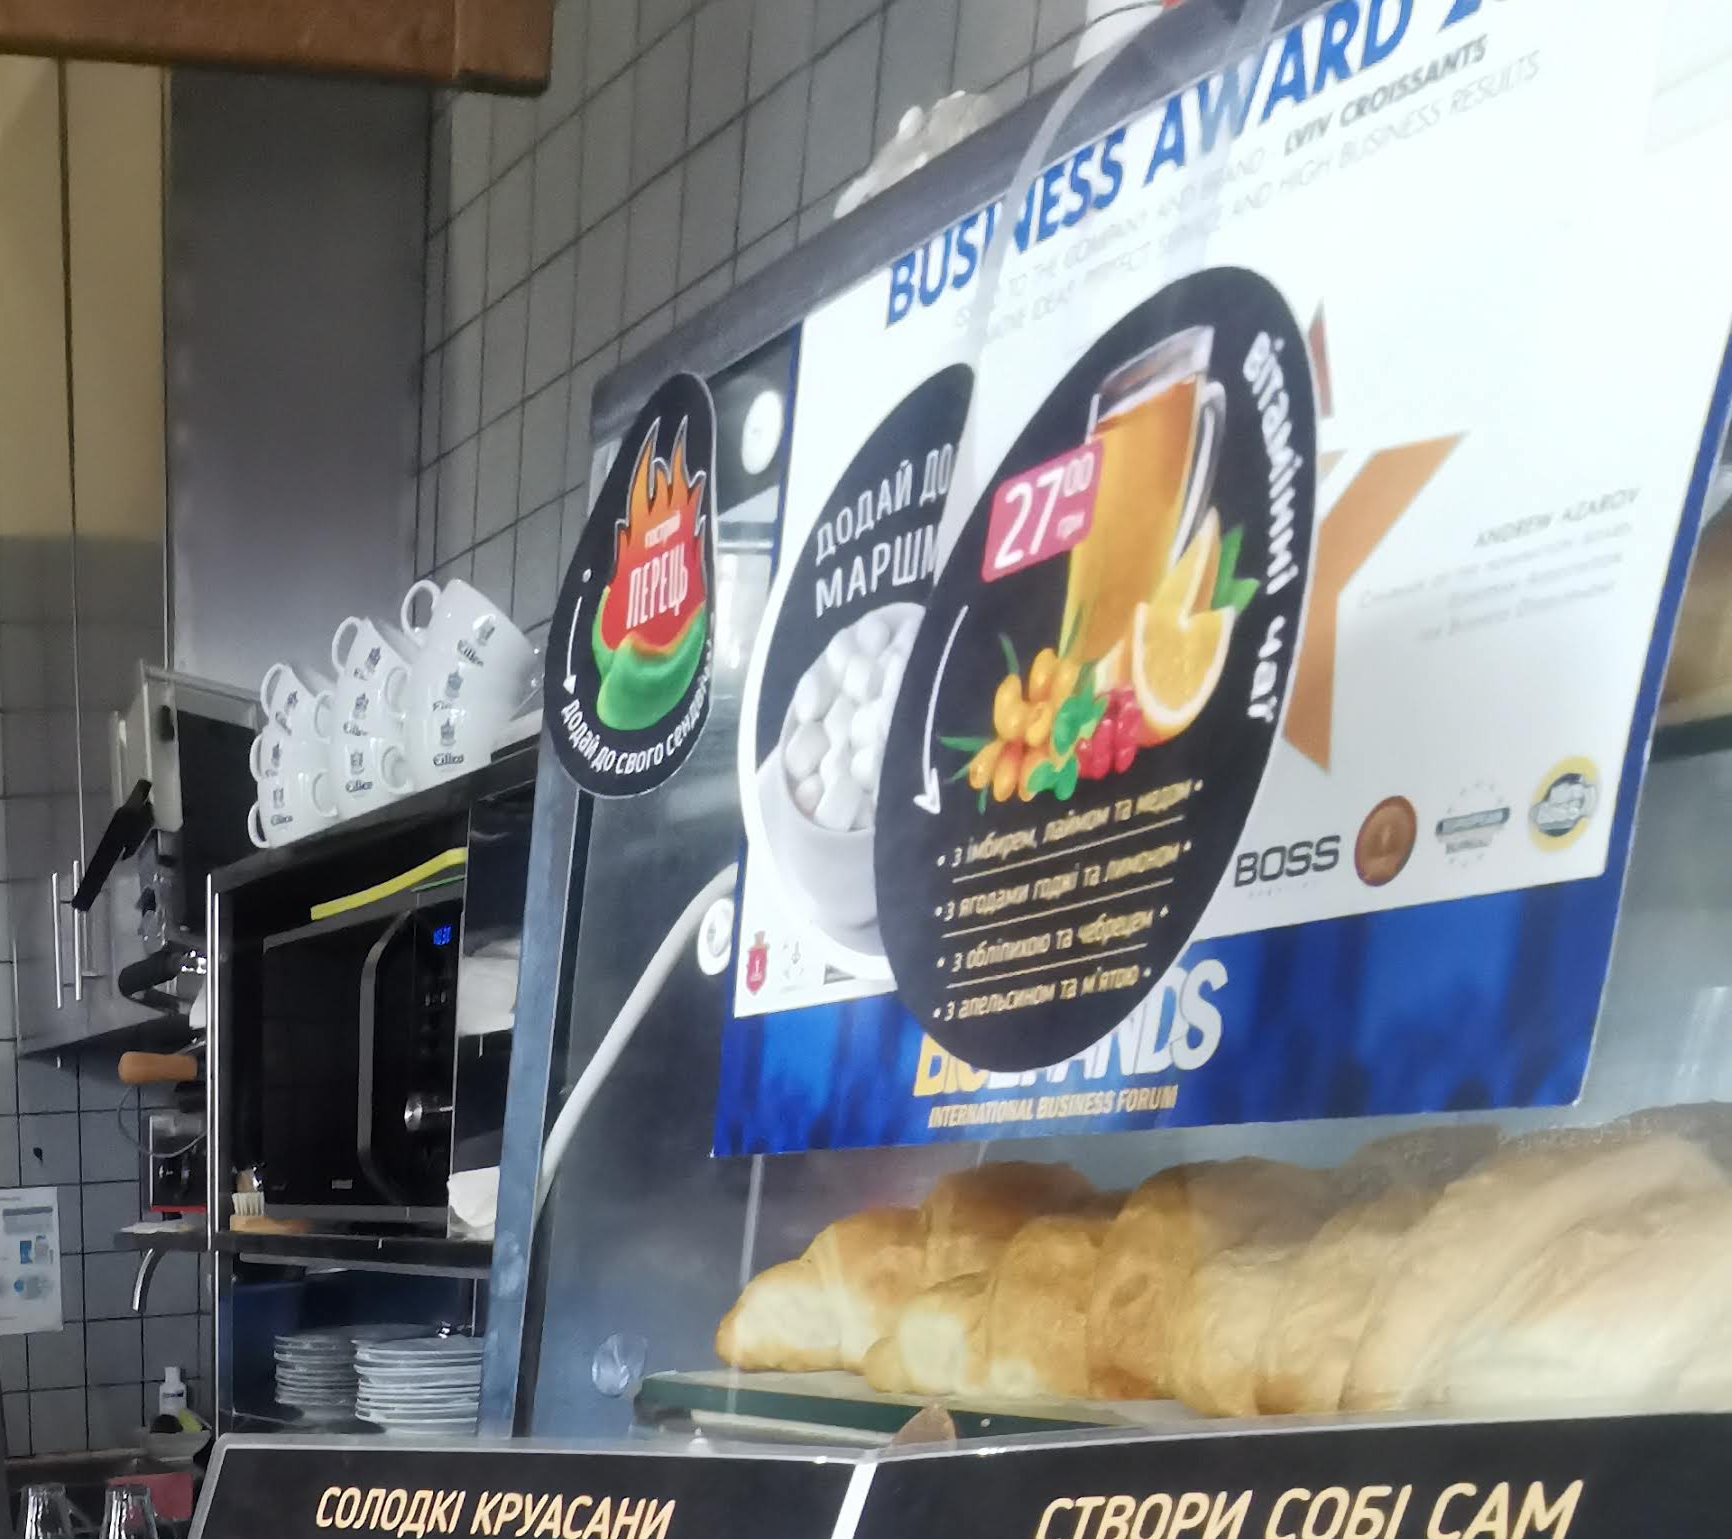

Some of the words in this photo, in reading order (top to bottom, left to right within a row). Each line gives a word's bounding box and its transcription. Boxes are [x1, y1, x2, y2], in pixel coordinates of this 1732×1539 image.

[814, 458, 914, 568] ДОДАЙ
[918, 442, 956, 508] ДО
[625, 542, 690, 632] ПЕРЕЦЬ
[615, 741, 665, 776] свого
[1233, 834, 1342, 888] BOSS
[927, 1096, 1035, 1130] INTERNATIONAL
[1035, 1090, 1114, 1116] BUSINESS
[1114, 1084, 1180, 1113] FORUM
